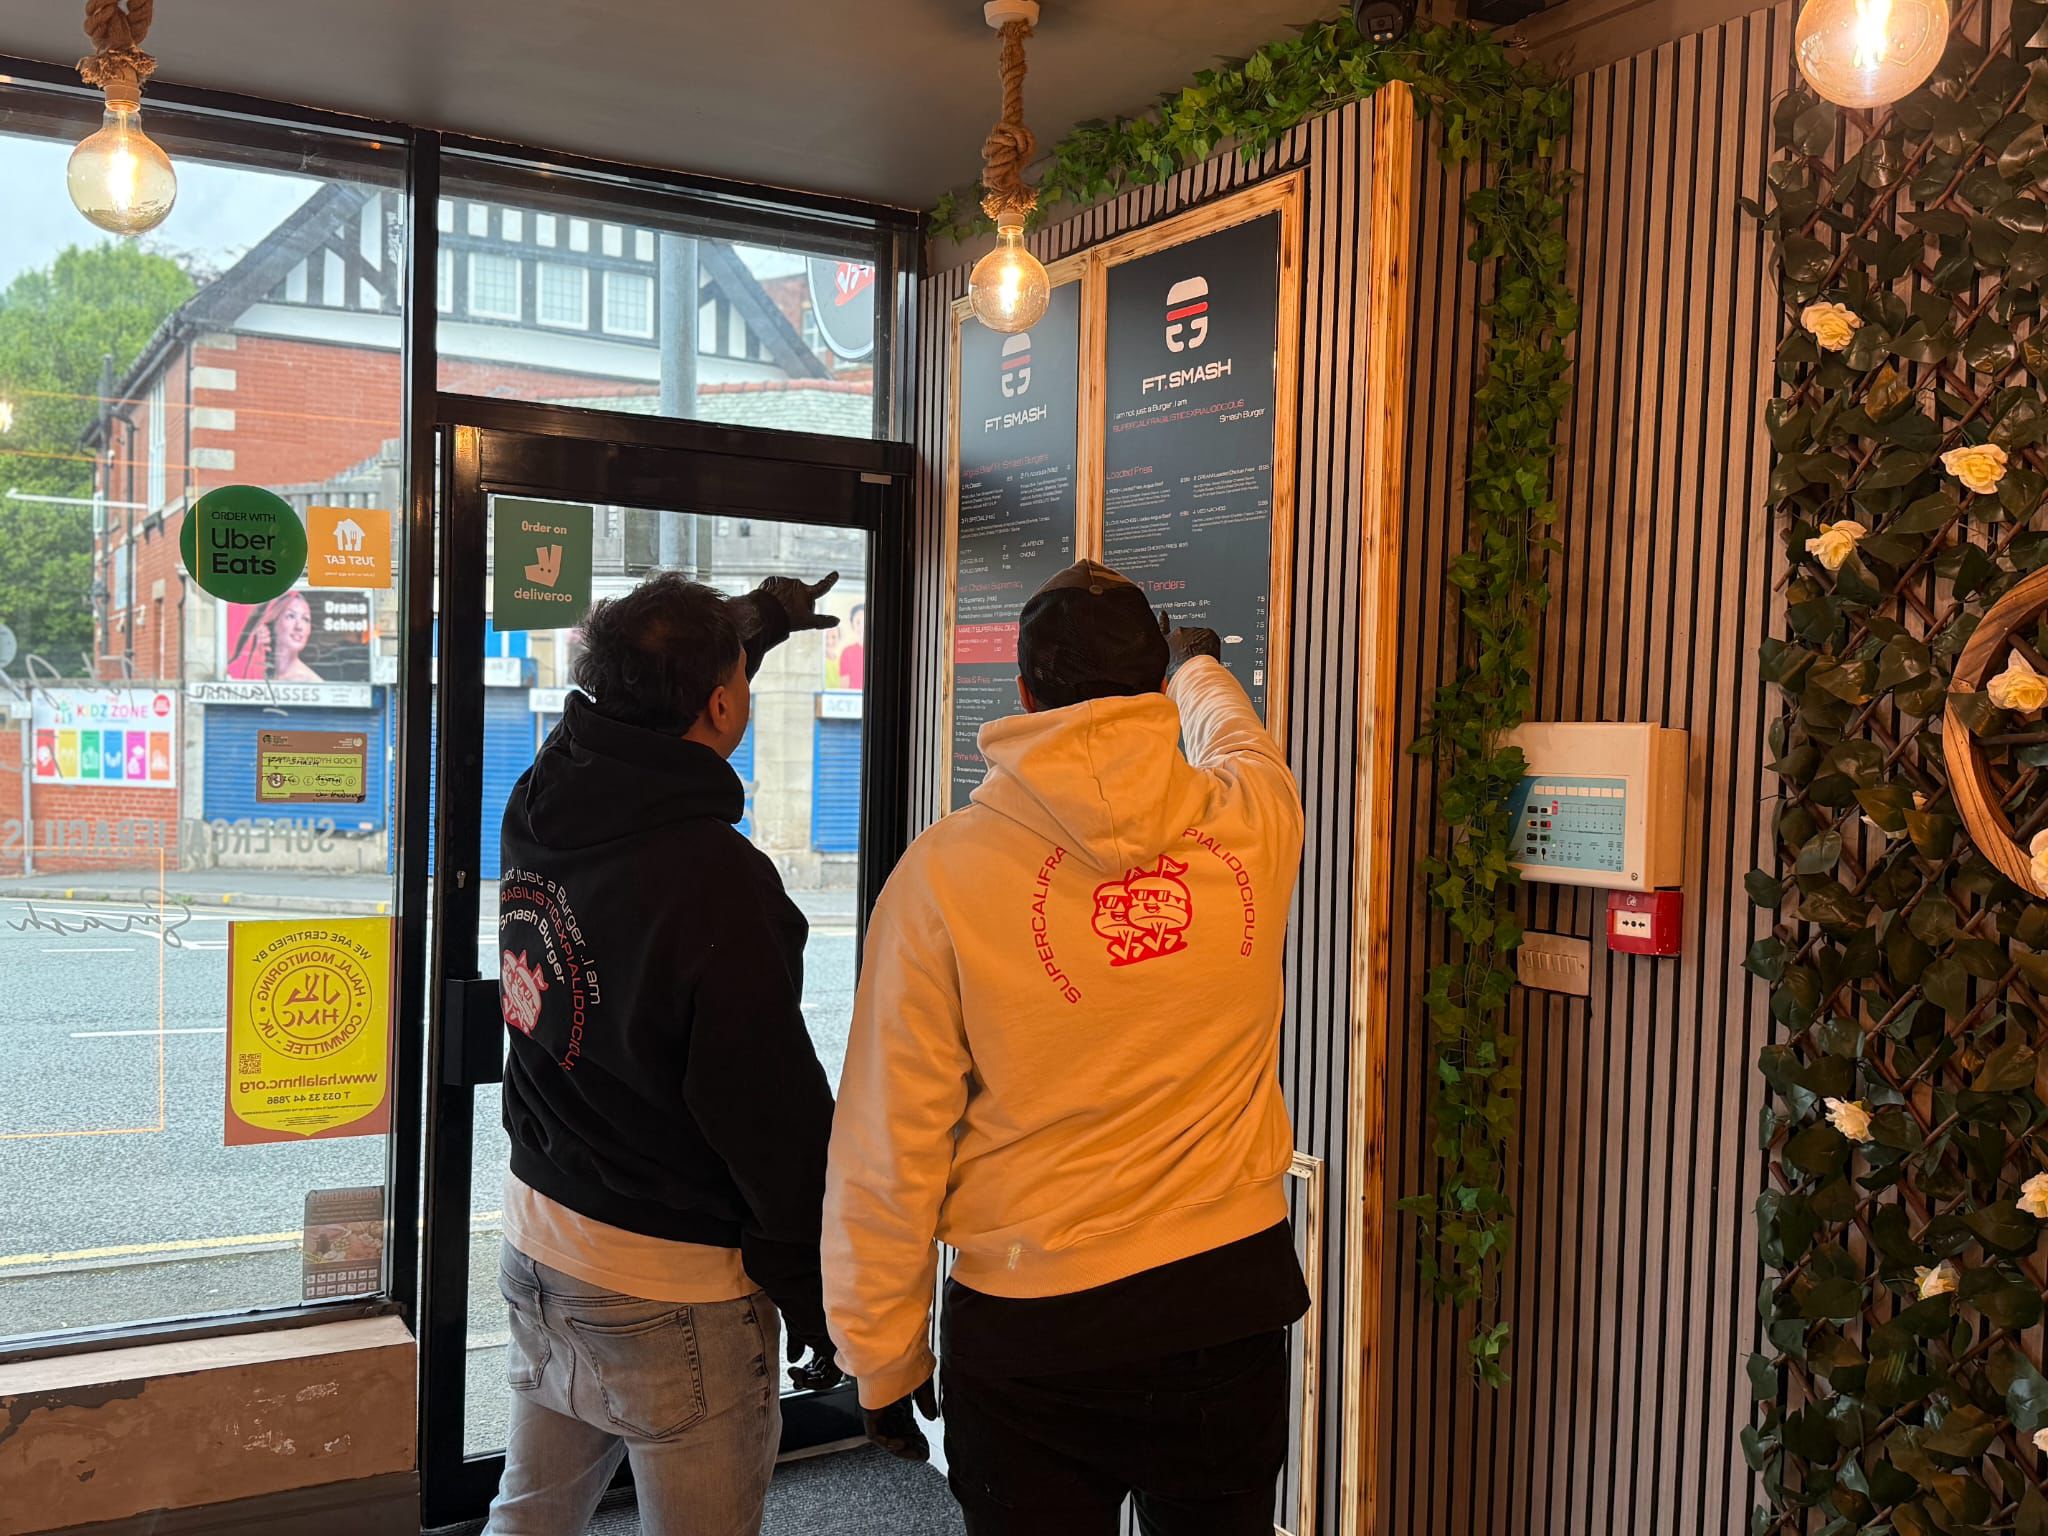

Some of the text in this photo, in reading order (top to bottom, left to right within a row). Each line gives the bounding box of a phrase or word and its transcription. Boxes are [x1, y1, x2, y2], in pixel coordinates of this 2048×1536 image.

[1142, 358, 1232, 395] FT.SMASH
[211, 511, 276, 523] ORDER WITH
[521, 520, 568, 535] Order on
[211, 527, 276, 551] Uber
[212, 552, 277, 576] Eats
[513, 587, 573, 602] deliveroo
[1148, 579, 1186, 592] Tenders
[324, 600, 368, 615] Drama
[323, 617, 368, 632] School
[76, 704, 109, 718] KIDZ
[111, 705, 149, 718] ZONE
[1181, 826, 1256, 958] PIALIDOCIOUS
[1031, 846, 1083, 1004] SUPERCALIFRA
[516, 866, 544, 886] just
[546, 880, 556, 893] a
[556, 886, 586, 948] Burger
[586, 969, 600, 1004] am
[499, 908, 566, 985] Smash Burger
